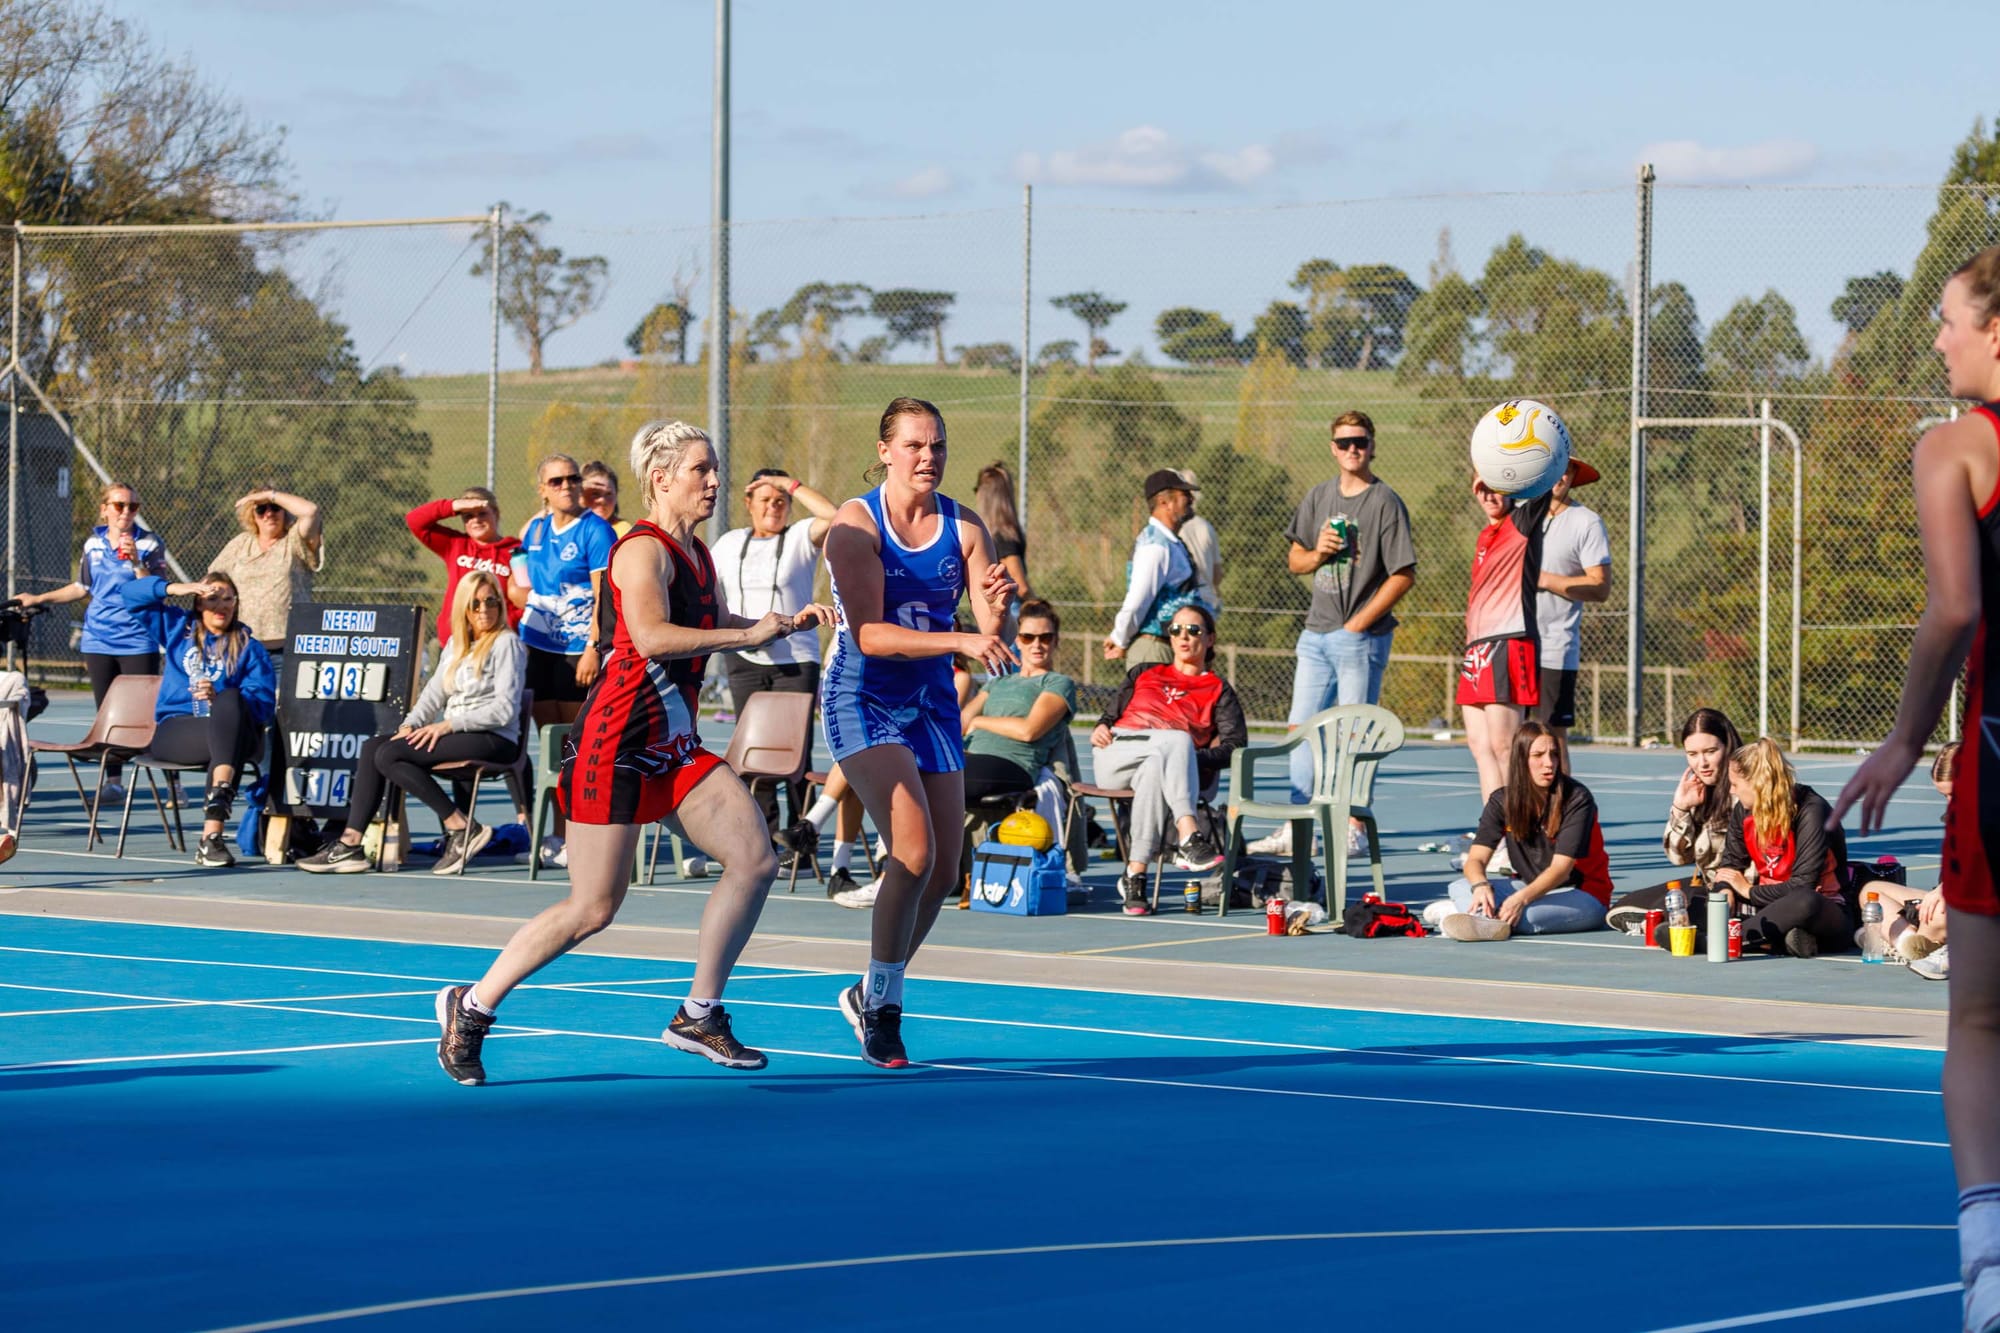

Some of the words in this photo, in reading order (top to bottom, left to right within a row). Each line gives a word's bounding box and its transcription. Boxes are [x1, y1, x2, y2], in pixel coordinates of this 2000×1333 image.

[884, 568, 905, 577] LK
[321, 609, 377, 632] NEERIM
[294, 634, 349, 656] NEERIM
[349, 635, 401, 657] SOUTH
[583, 705, 614, 801] DARNUM
